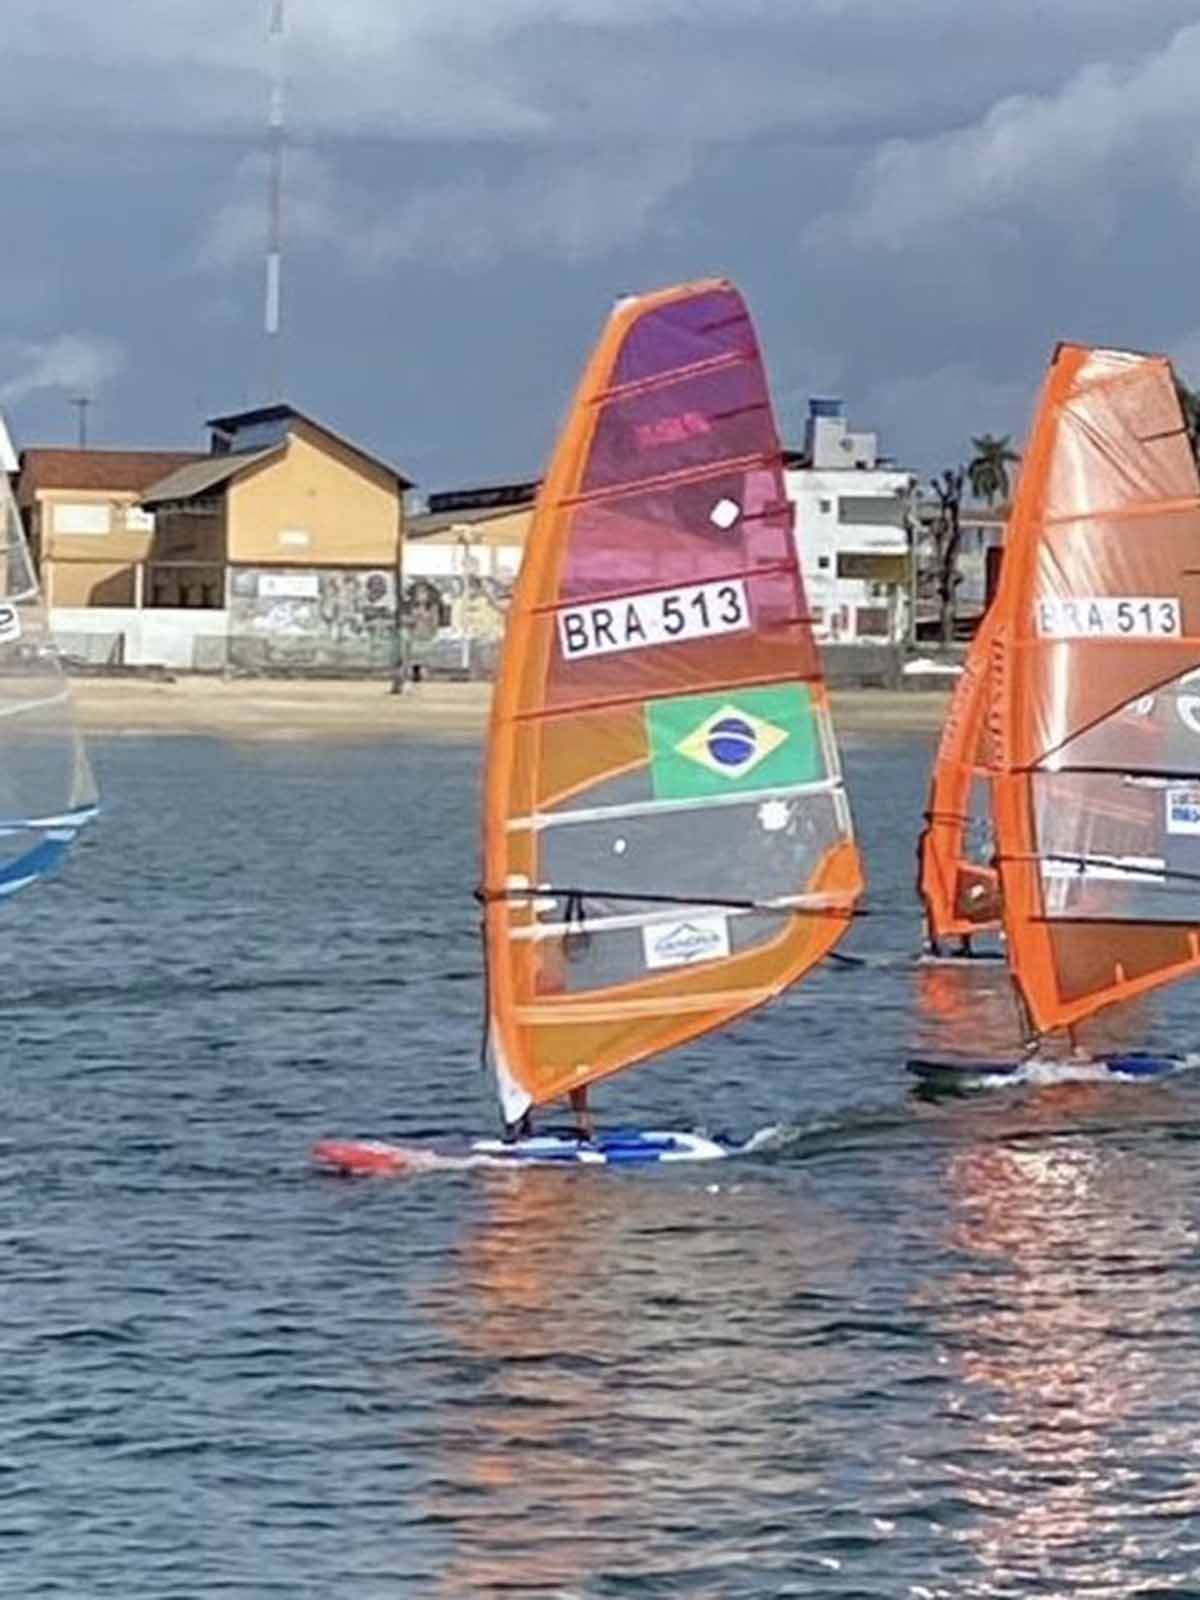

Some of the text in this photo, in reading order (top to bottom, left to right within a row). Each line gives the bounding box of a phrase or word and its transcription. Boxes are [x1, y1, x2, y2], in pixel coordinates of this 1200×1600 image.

[563, 587, 742, 652] BRA 513
[1117, 602, 1177, 633] 513
